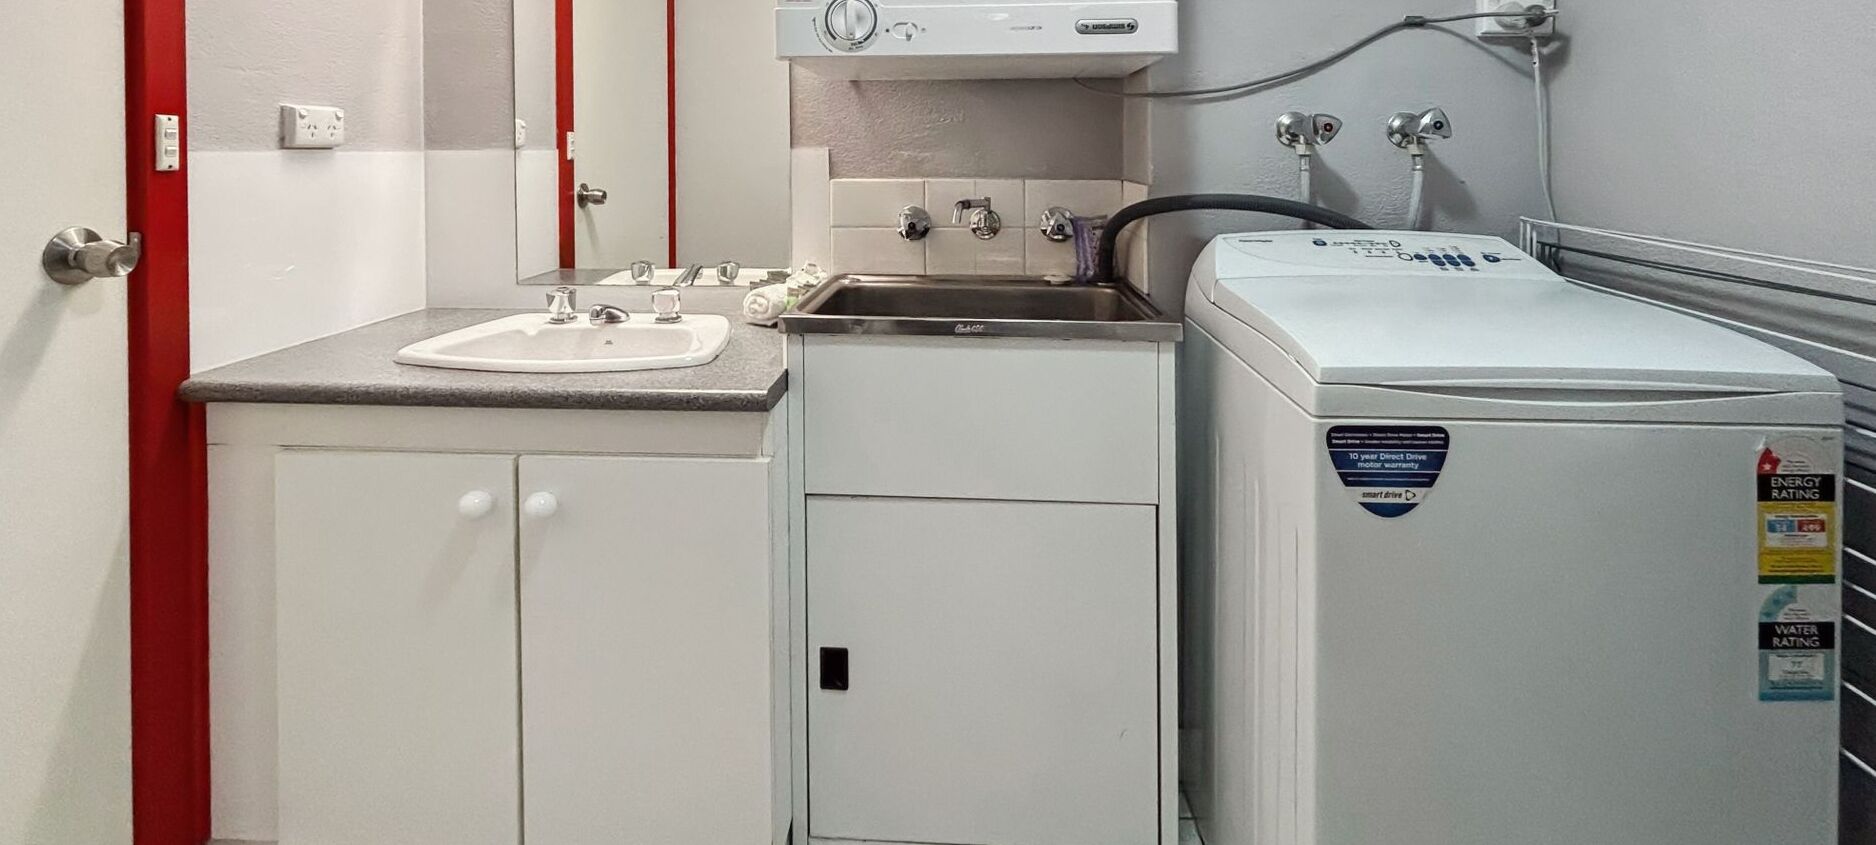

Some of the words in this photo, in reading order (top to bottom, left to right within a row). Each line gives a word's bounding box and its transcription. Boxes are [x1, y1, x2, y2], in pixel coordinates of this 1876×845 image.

[1349, 452, 1358, 460] 10
[1379, 452, 1404, 460] Direct
[1406, 453, 1427, 461] Drive
[1383, 462, 1419, 470] warranty
[1771, 476, 1822, 488] ENERGY
[1383, 490, 1402, 498] drive
[1771, 489, 1820, 500] RATING
[1774, 624, 1820, 635] WATER
[1772, 637, 1820, 648] RATING
